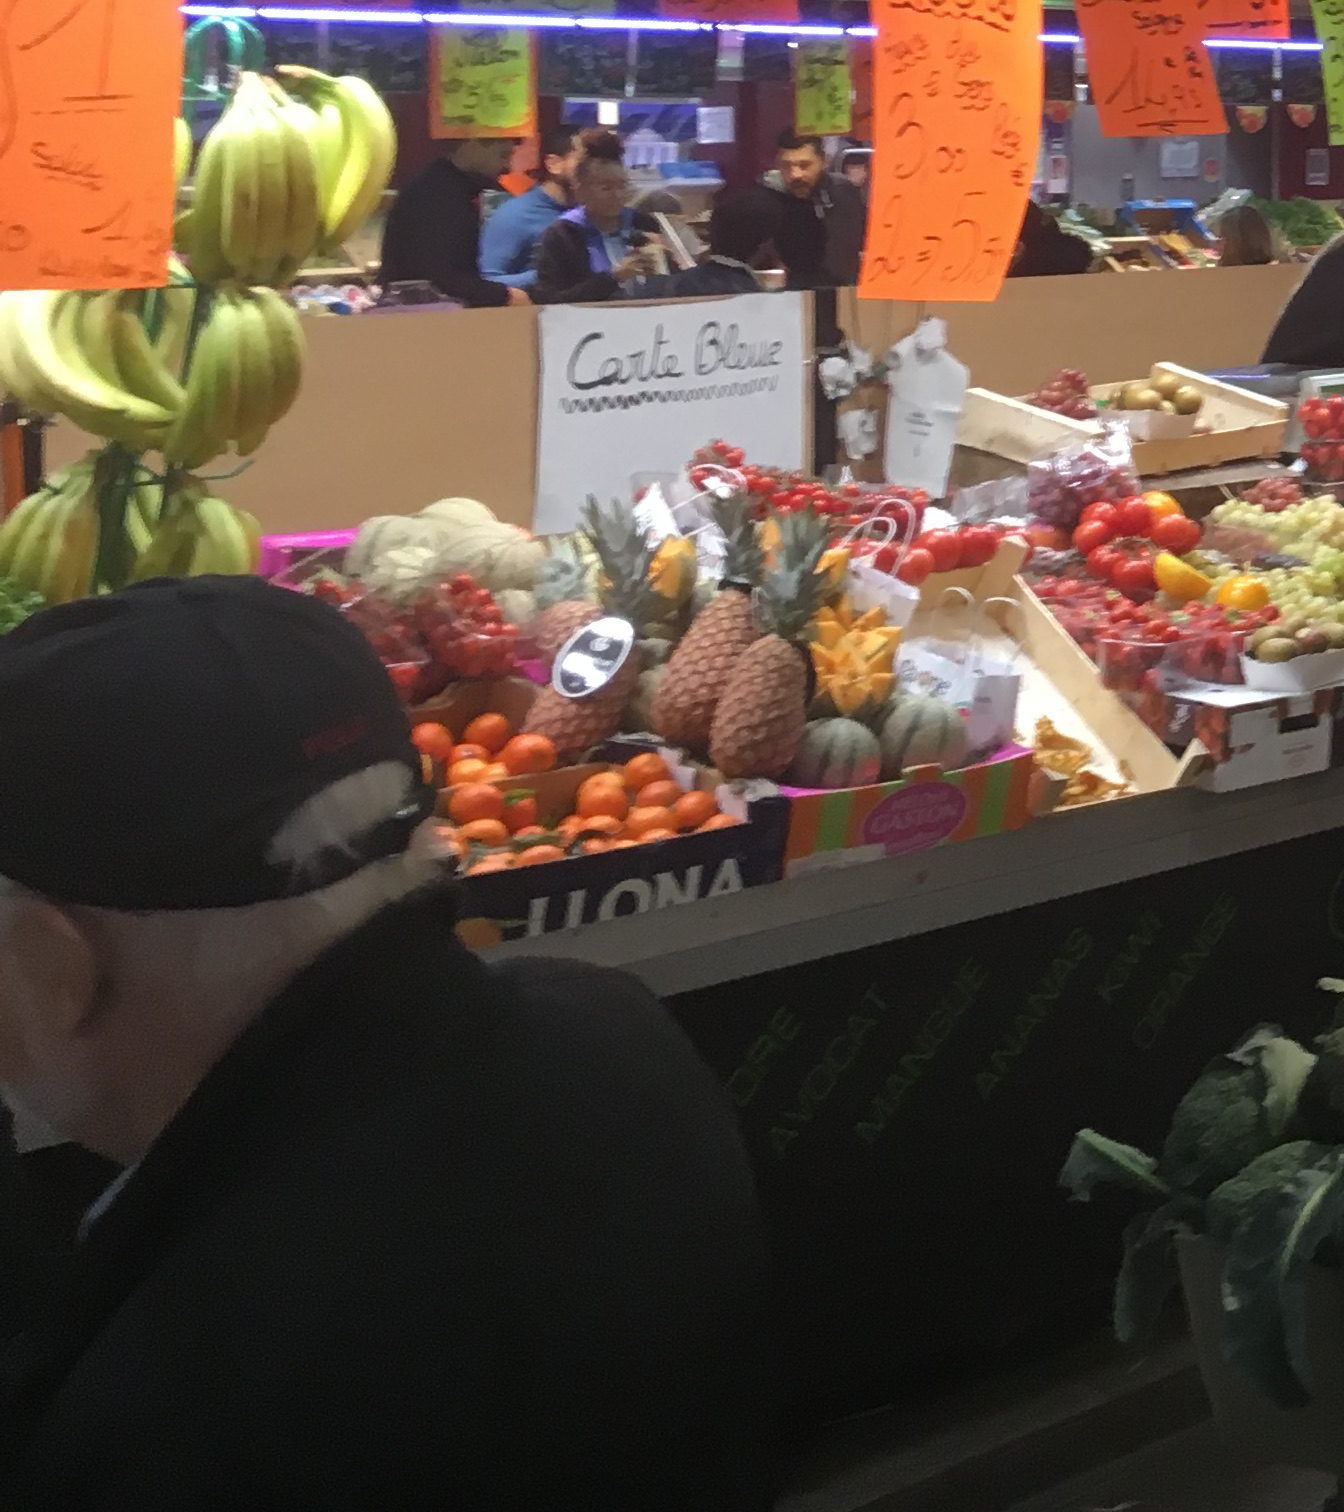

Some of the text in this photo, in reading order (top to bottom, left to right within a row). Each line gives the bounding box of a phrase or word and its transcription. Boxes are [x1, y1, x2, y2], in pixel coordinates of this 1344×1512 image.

[567, 320, 783, 391] Carte Bleue
[853, 957, 989, 1145] MANGUE
[976, 927, 1093, 1100] ANANAS
[1132, 893, 1238, 1050] ORANGE
[769, 982, 888, 1160] AVOCAT
